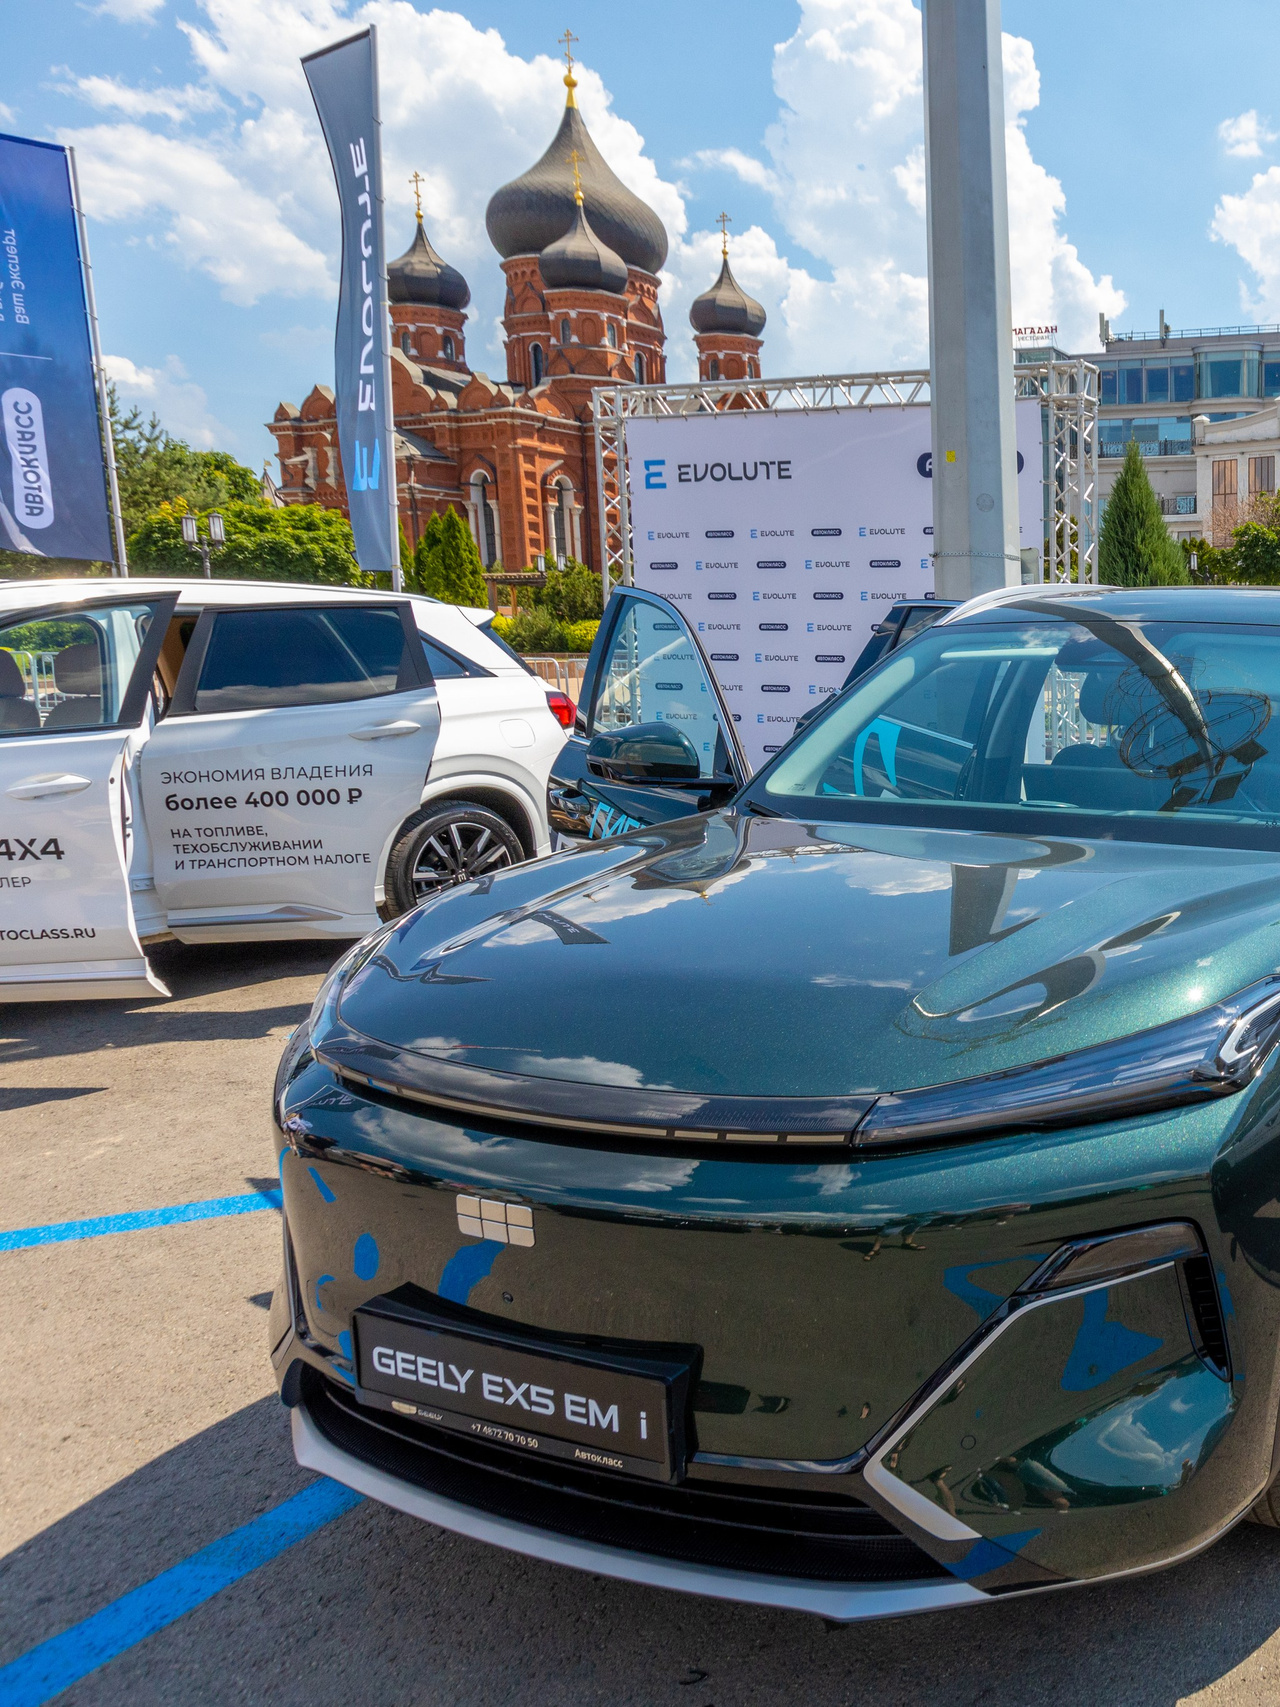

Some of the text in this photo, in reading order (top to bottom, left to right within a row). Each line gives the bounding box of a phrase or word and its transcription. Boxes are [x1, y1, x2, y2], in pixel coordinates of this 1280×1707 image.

[678, 460, 792, 482] EVOLUTE
[160, 764, 373, 785] ЭКОНОМИЯ ВЛАДЕНИЯ
[165, 794, 238, 811] более
[245, 790, 289, 808] 400
[296, 788, 341, 806] 000
[170, 825, 268, 839] НА ТОПЛИВЕ,
[173, 839, 323, 855] ТЕХОБСЛУЖИВАНИИ
[175, 853, 371, 870] И ТРАНСПОРТНОМ НАЛОГЕ
[372, 1346, 474, 1393] GEELY
[482, 1372, 555, 1415] EX5
[564, 1393, 619, 1433] EM
[471, 1423, 539, 1448] +7 4872 70 70 50
[574, 1448, 623, 1468] Автокласс
